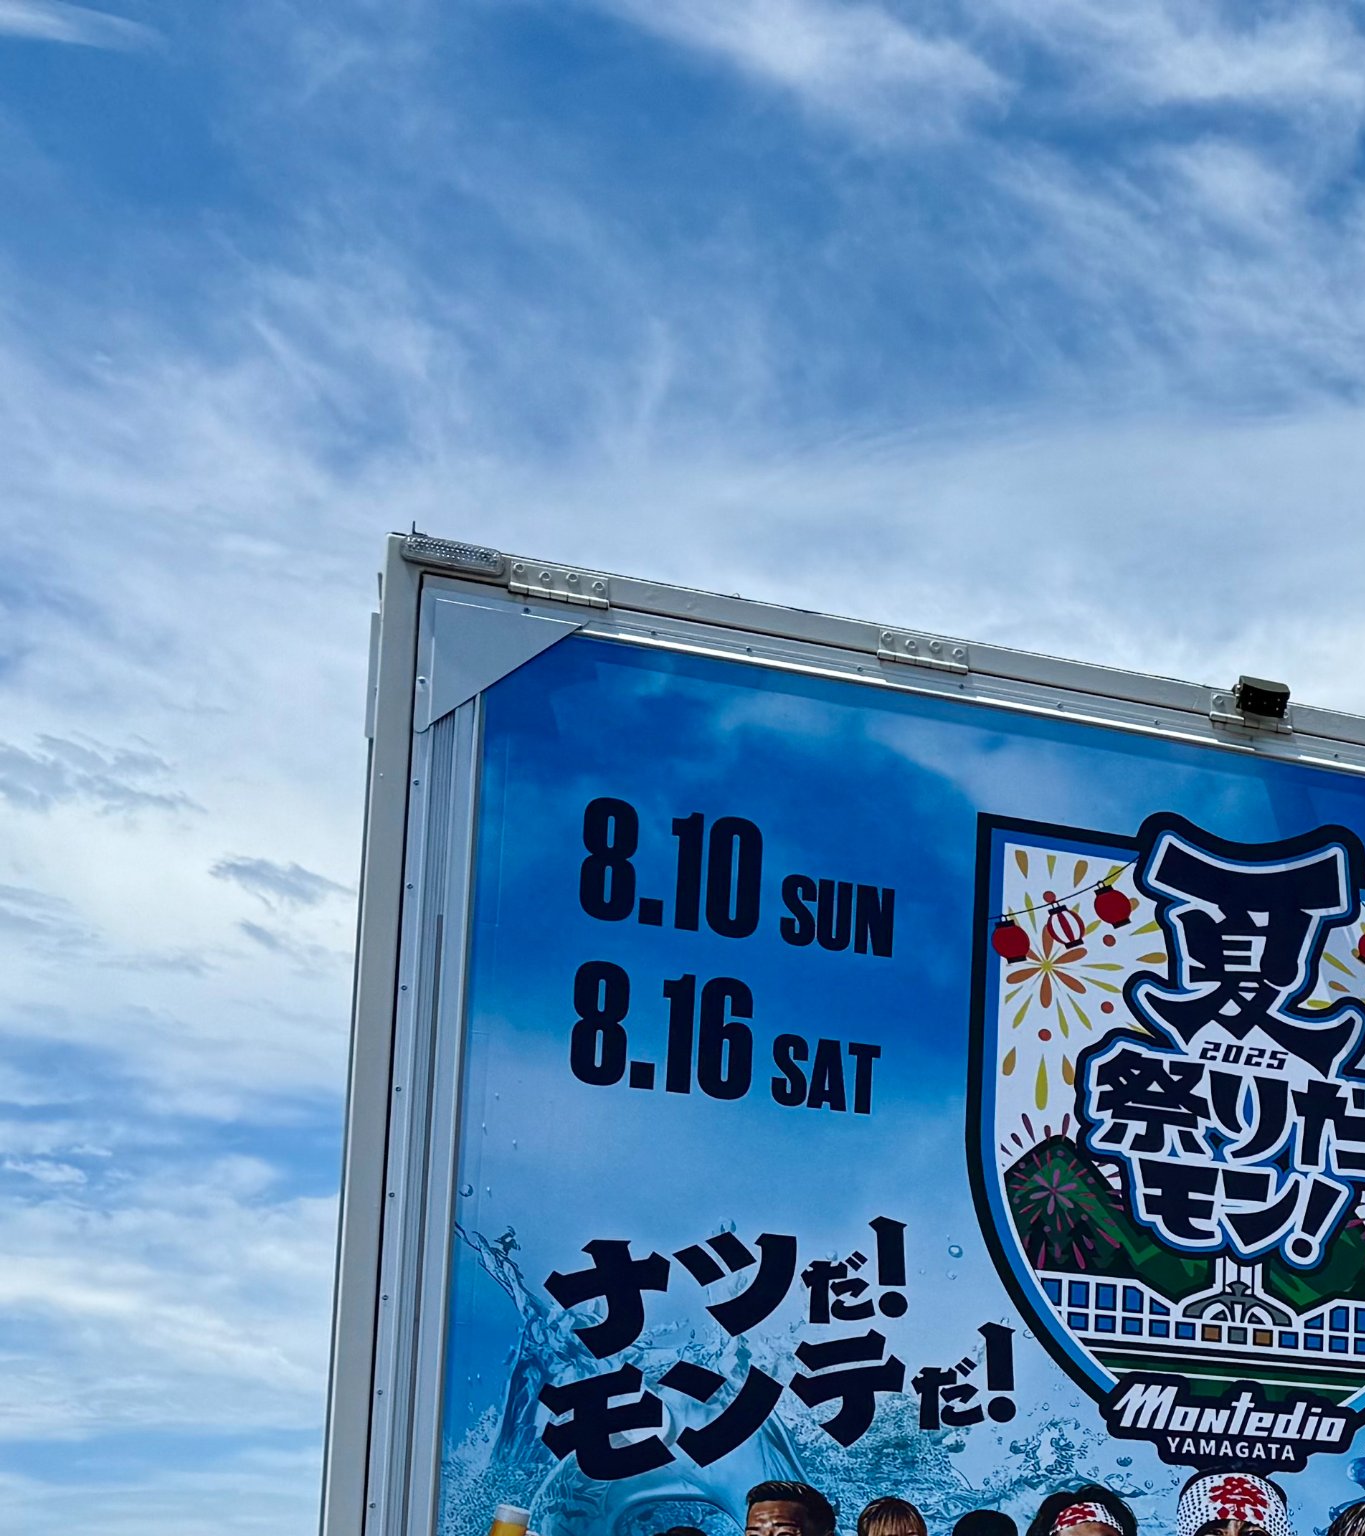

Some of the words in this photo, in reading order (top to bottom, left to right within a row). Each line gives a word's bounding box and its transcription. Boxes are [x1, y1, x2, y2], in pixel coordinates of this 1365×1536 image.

[579, 797, 763, 939] 8.10
[780, 874, 895, 957] SUN
[1144, 833, 1358, 1078] 夏
[570, 960, 754, 1101] 8.16
[771, 1034, 881, 1115] SAT
[1199, 1041, 1289, 1070] 2025
[1112, 1383, 1347, 1442] Montedio
[1166, 1436, 1295, 1461] YAMAGATA
